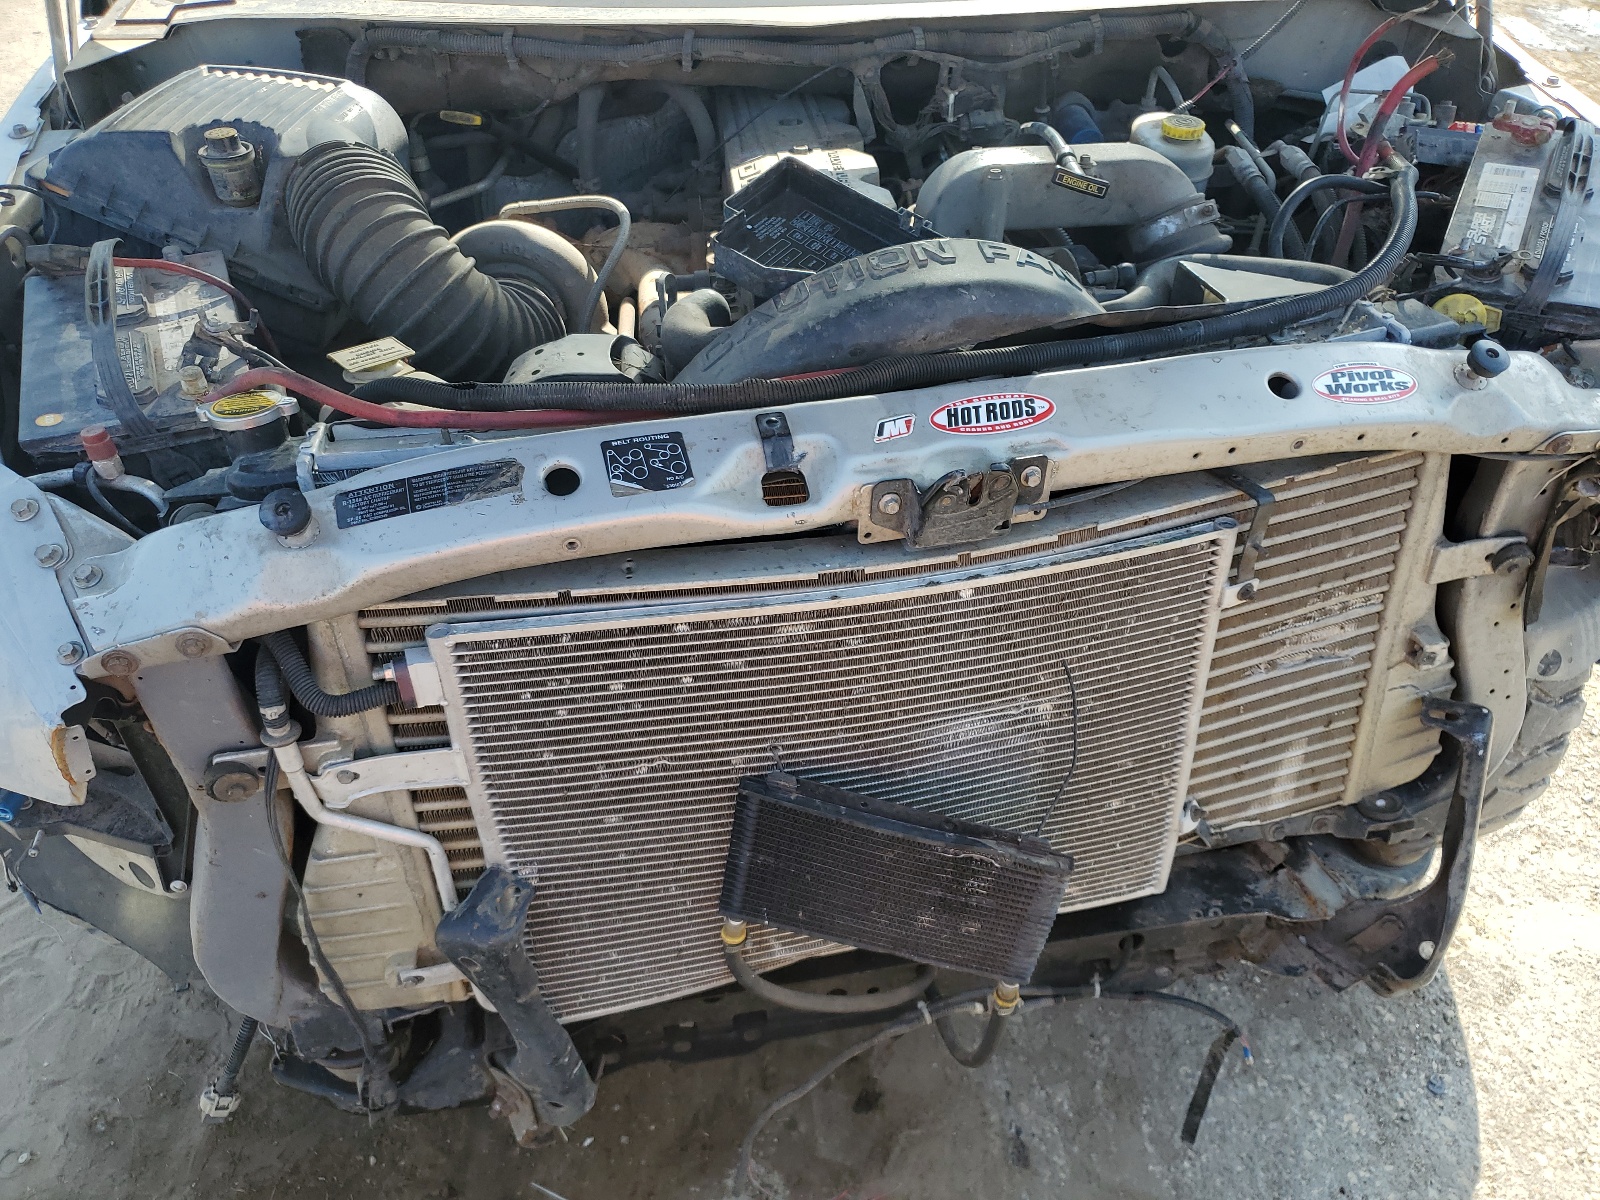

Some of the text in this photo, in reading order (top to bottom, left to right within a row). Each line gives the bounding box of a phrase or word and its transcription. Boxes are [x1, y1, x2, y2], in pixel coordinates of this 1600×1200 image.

[1062, 175, 1099, 193] ENGINE OIL
[1466, 212, 1485, 240] SUPER
[1474, 212, 1492, 246] START
[704, 238, 1084, 373] CAUTION FAN
[1330, 369, 1395, 382] Pivot
[1324, 380, 1410, 396] Works
[948, 393, 1026, 408] THE ORIGINAL
[946, 405, 982, 428] HOT
[986, 398, 1037, 423] RODS
[1012, 417, 1034, 428] RODS
[611, 433, 670, 447] BELT ROUTING
[348, 483, 395, 498] ATTENTION
